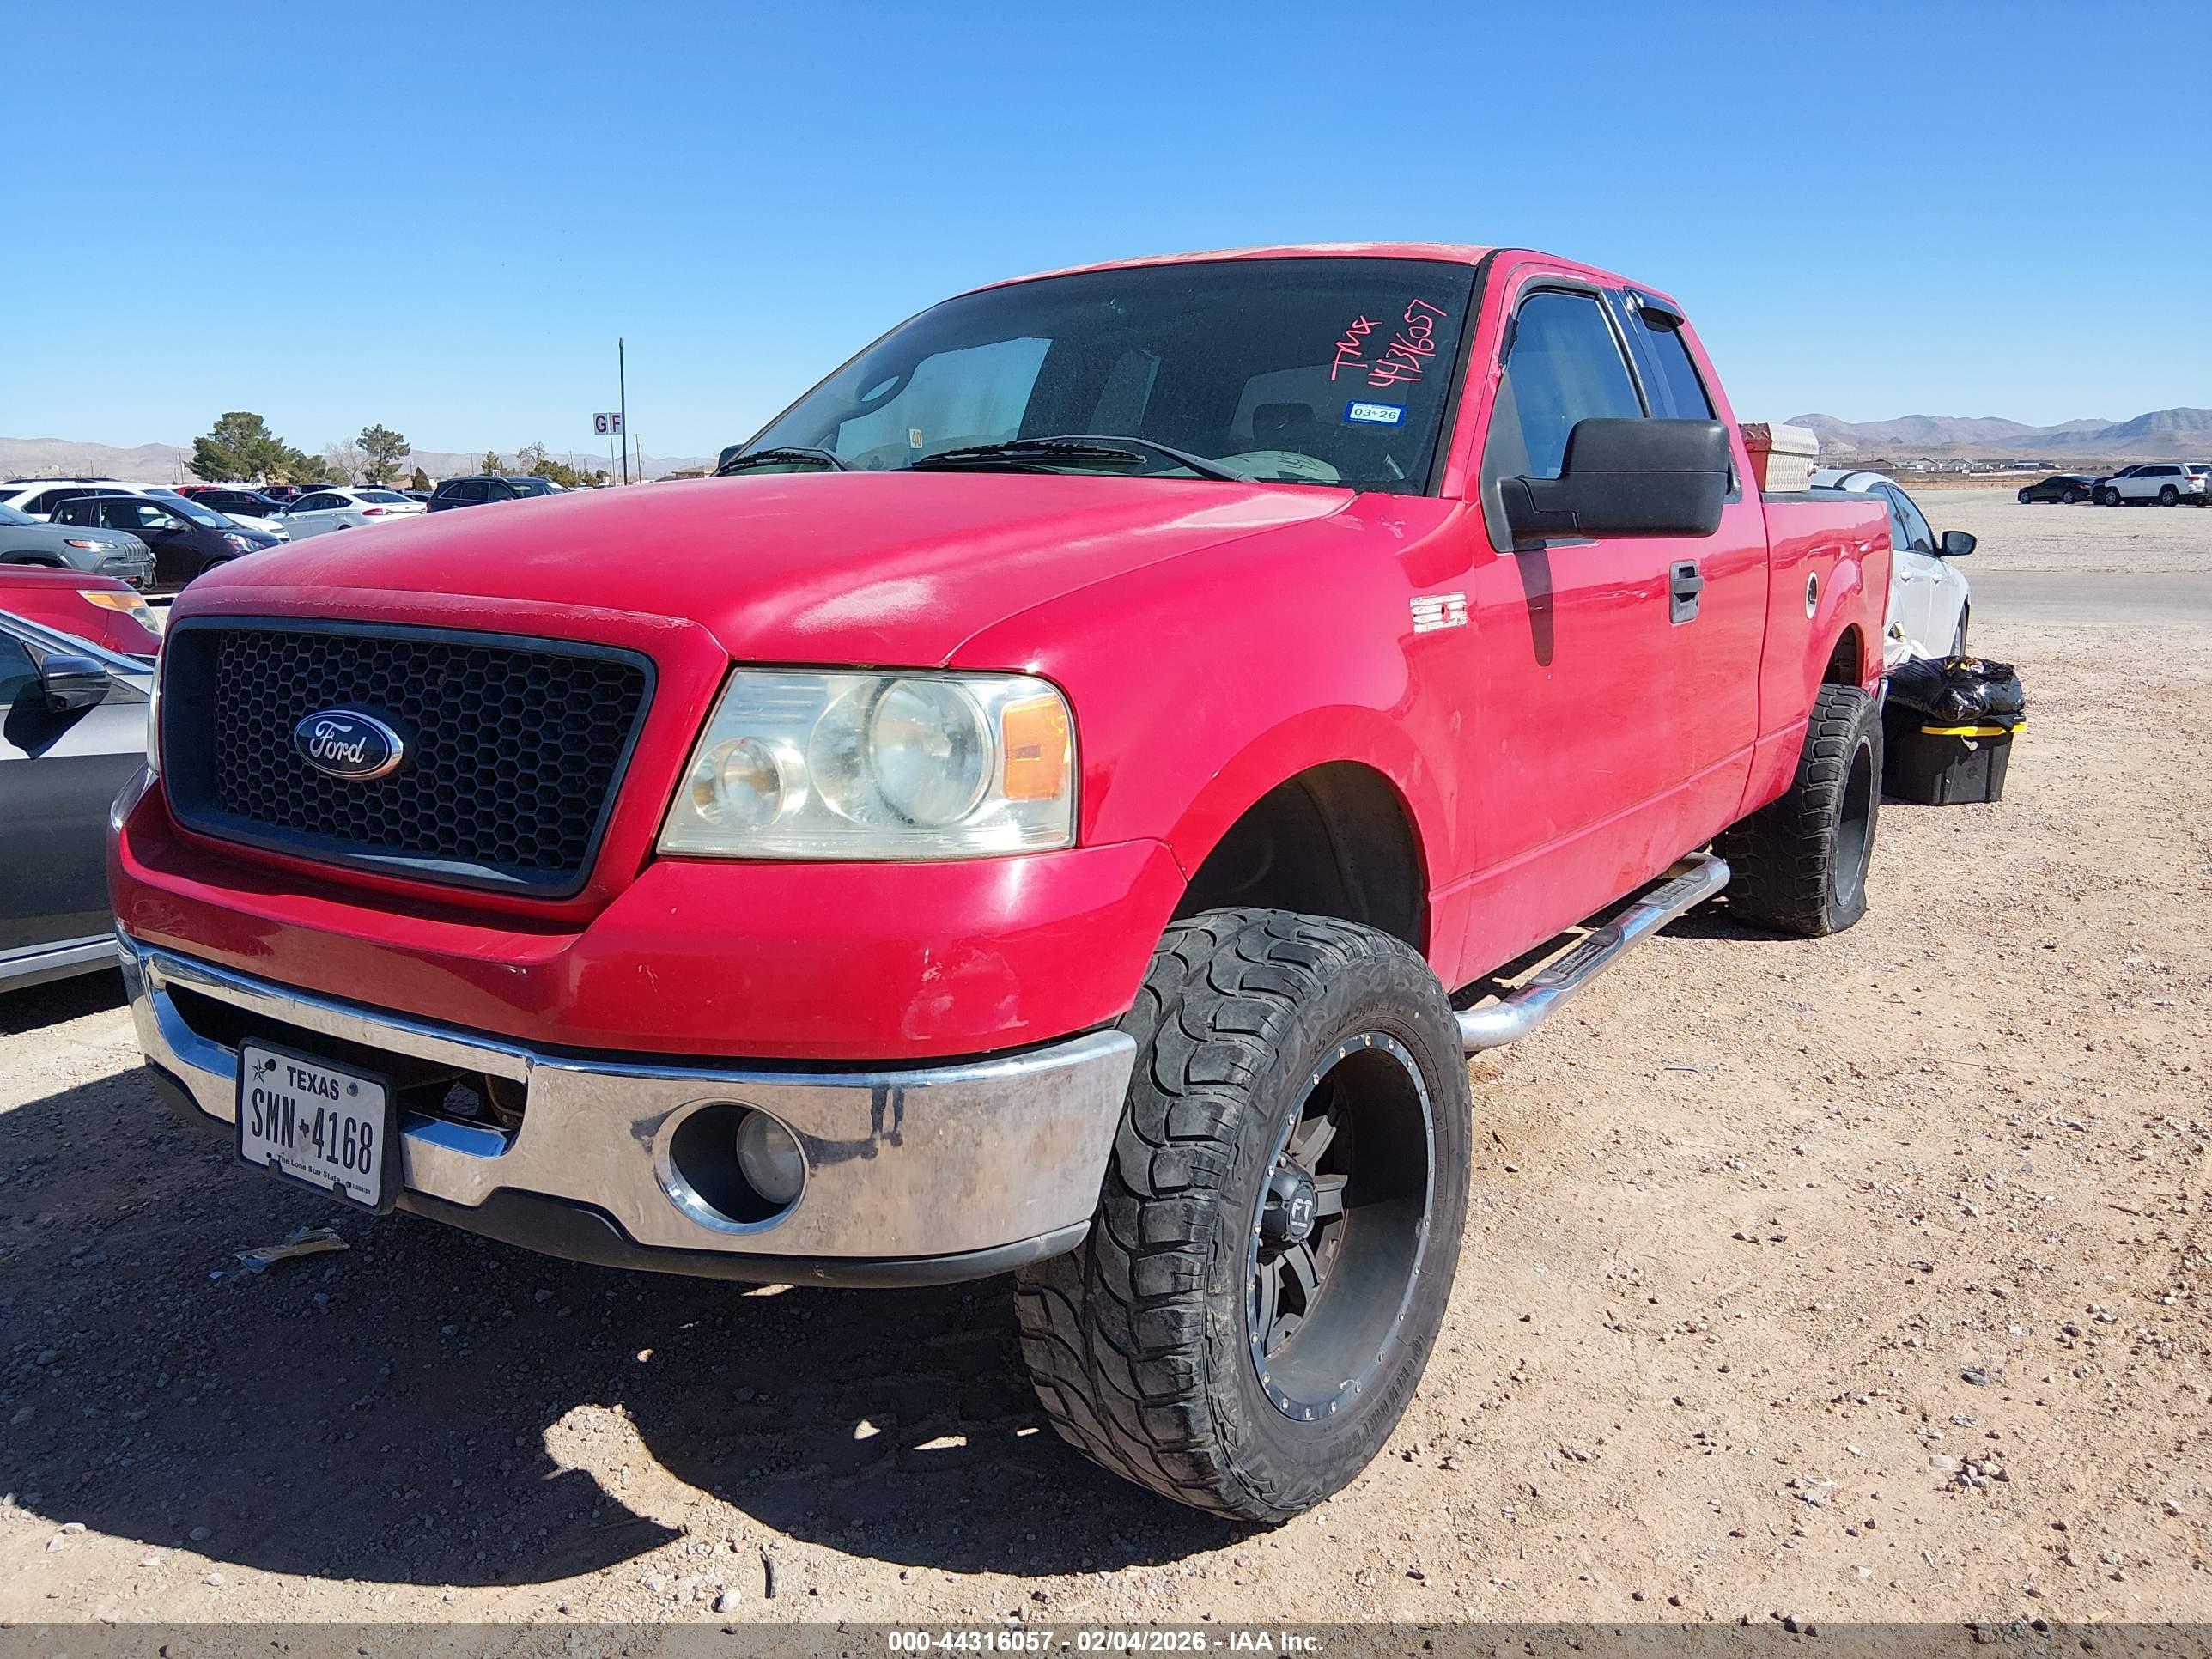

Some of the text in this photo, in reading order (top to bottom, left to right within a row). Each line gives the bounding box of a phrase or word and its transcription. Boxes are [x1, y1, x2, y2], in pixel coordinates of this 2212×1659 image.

[1368, 299, 1447, 386] 44316057
[595, 415, 621, 433] G F
[1379, 410, 1397, 420] 26
[309, 720, 368, 763] Ford
[287, 1065, 340, 1101] TEXAS
[251, 1088, 374, 1175] SMN 4168
[277, 1154, 341, 1183] The Lone Star State
